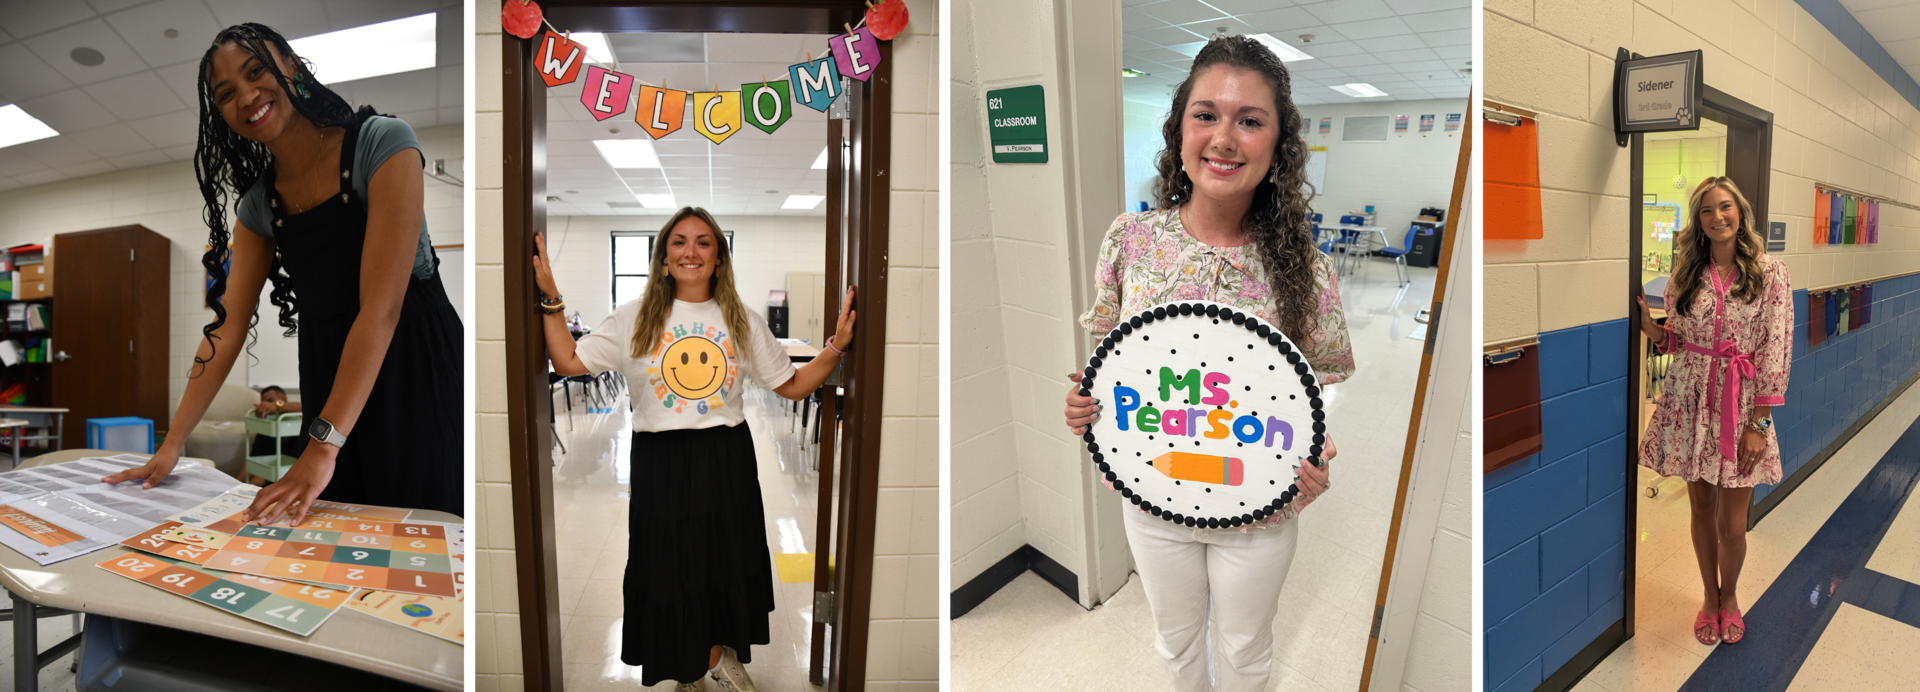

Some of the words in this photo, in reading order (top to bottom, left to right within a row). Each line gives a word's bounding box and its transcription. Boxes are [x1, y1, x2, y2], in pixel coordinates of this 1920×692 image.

[541, 34, 871, 135] WELCOME
[1637, 80, 1674, 93] Sidener
[989, 97, 1003, 110] 621
[1638, 101, 1650, 112] 3rd
[1651, 100, 1673, 111] Grade
[994, 115, 1037, 128] CLASSROOM
[662, 323, 688, 343] OH
[691, 321, 726, 343] HEY
[646, 366, 688, 414] FIRST
[697, 365, 738, 415] GRADE
[1159, 366, 1239, 409] Ms.
[1113, 385, 1294, 451] Pearson
[311, 502, 363, 513] April
[309, 520, 333, 529] 15
[358, 523, 383, 532] 14
[252, 527, 277, 537] 12
[303, 531, 324, 541] 11
[404, 526, 431, 536] 13
[246, 540, 264, 550] 8
[351, 535, 379, 545] 10
[409, 540, 426, 549] 9
[298, 546, 316, 556] 7
[351, 550, 369, 561] 6
[116, 558, 155, 572] 20
[230, 556, 249, 566] 4
[410, 556, 427, 567] 5
[288, 562, 307, 574] 3
[346, 568, 365, 580] 2
[161, 573, 195, 588] 19
[415, 575, 427, 588] 1
[210, 587, 246, 605] 18
[265, 605, 305, 623] 17
